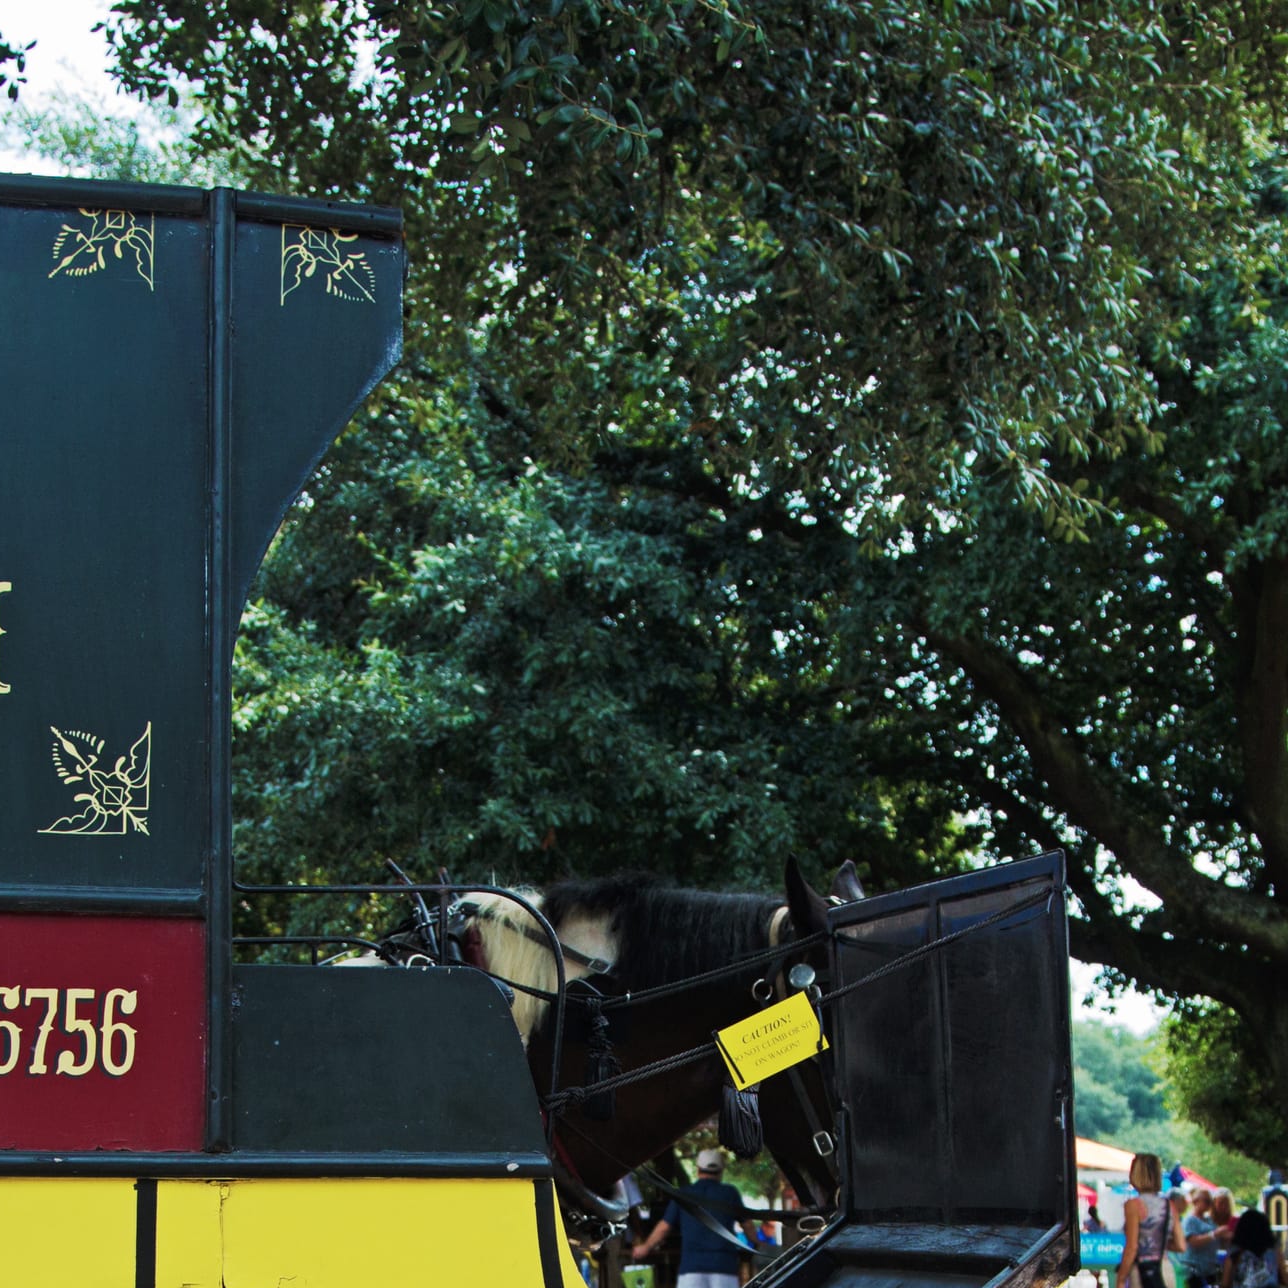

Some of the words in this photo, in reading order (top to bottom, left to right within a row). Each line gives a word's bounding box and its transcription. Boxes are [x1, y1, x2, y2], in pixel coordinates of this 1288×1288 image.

[742, 1013, 792, 1045] CAUTION!
[744, 1045, 760, 1057] NOT
[762, 1033, 788, 1049] CLIMB
[789, 1026, 800, 1037] OR
[802, 1019, 814, 1030] SIT
[754, 1056, 768, 1067] ON
